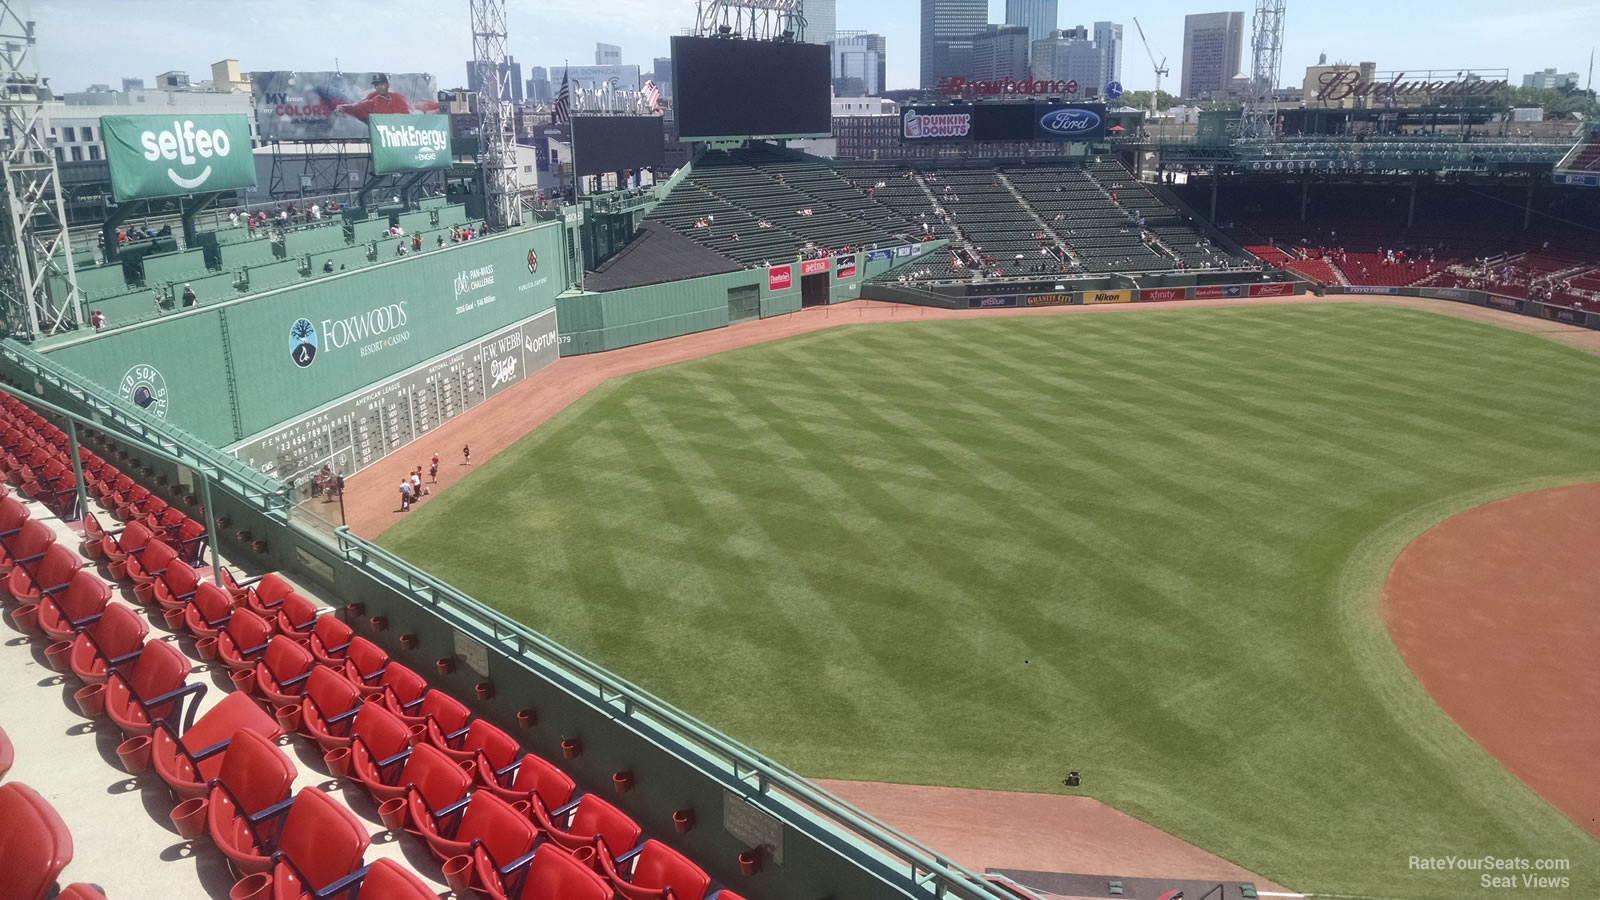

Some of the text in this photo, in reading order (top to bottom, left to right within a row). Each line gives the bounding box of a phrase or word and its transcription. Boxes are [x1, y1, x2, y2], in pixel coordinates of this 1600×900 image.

[1004, 76, 1078, 95] balance
[1318, 70, 1508, 101] Budweiser
[265, 93, 287, 104] MY
[922, 113, 970, 126] DUNKIN'
[1051, 112, 1089, 130] Ford
[376, 124, 447, 150] ThinkEnergy
[922, 125, 968, 137] DONUTS
[469, 264, 494, 280] PAN-MASS
[805, 261, 825, 273] aetna
[470, 275, 495, 291] CHALLENGE
[1058, 294, 1073, 303] CITY
[1094, 293, 1120, 301] Nikon
[1150, 290, 1176, 300] xfinity
[321, 301, 408, 353] FOXWOODS
[360, 329, 410, 358] RESORT CASINO
[498, 332, 521, 354] WEBB
[532, 330, 556, 353] OPTUM
[135, 367, 157, 383] SOX
[356, 382, 401, 407] AMERICAN LEAGUE
[261, 413, 329, 448] FENWAY PARK
[322, 424, 328, 433] 10
[261, 461, 273, 473] CWS
